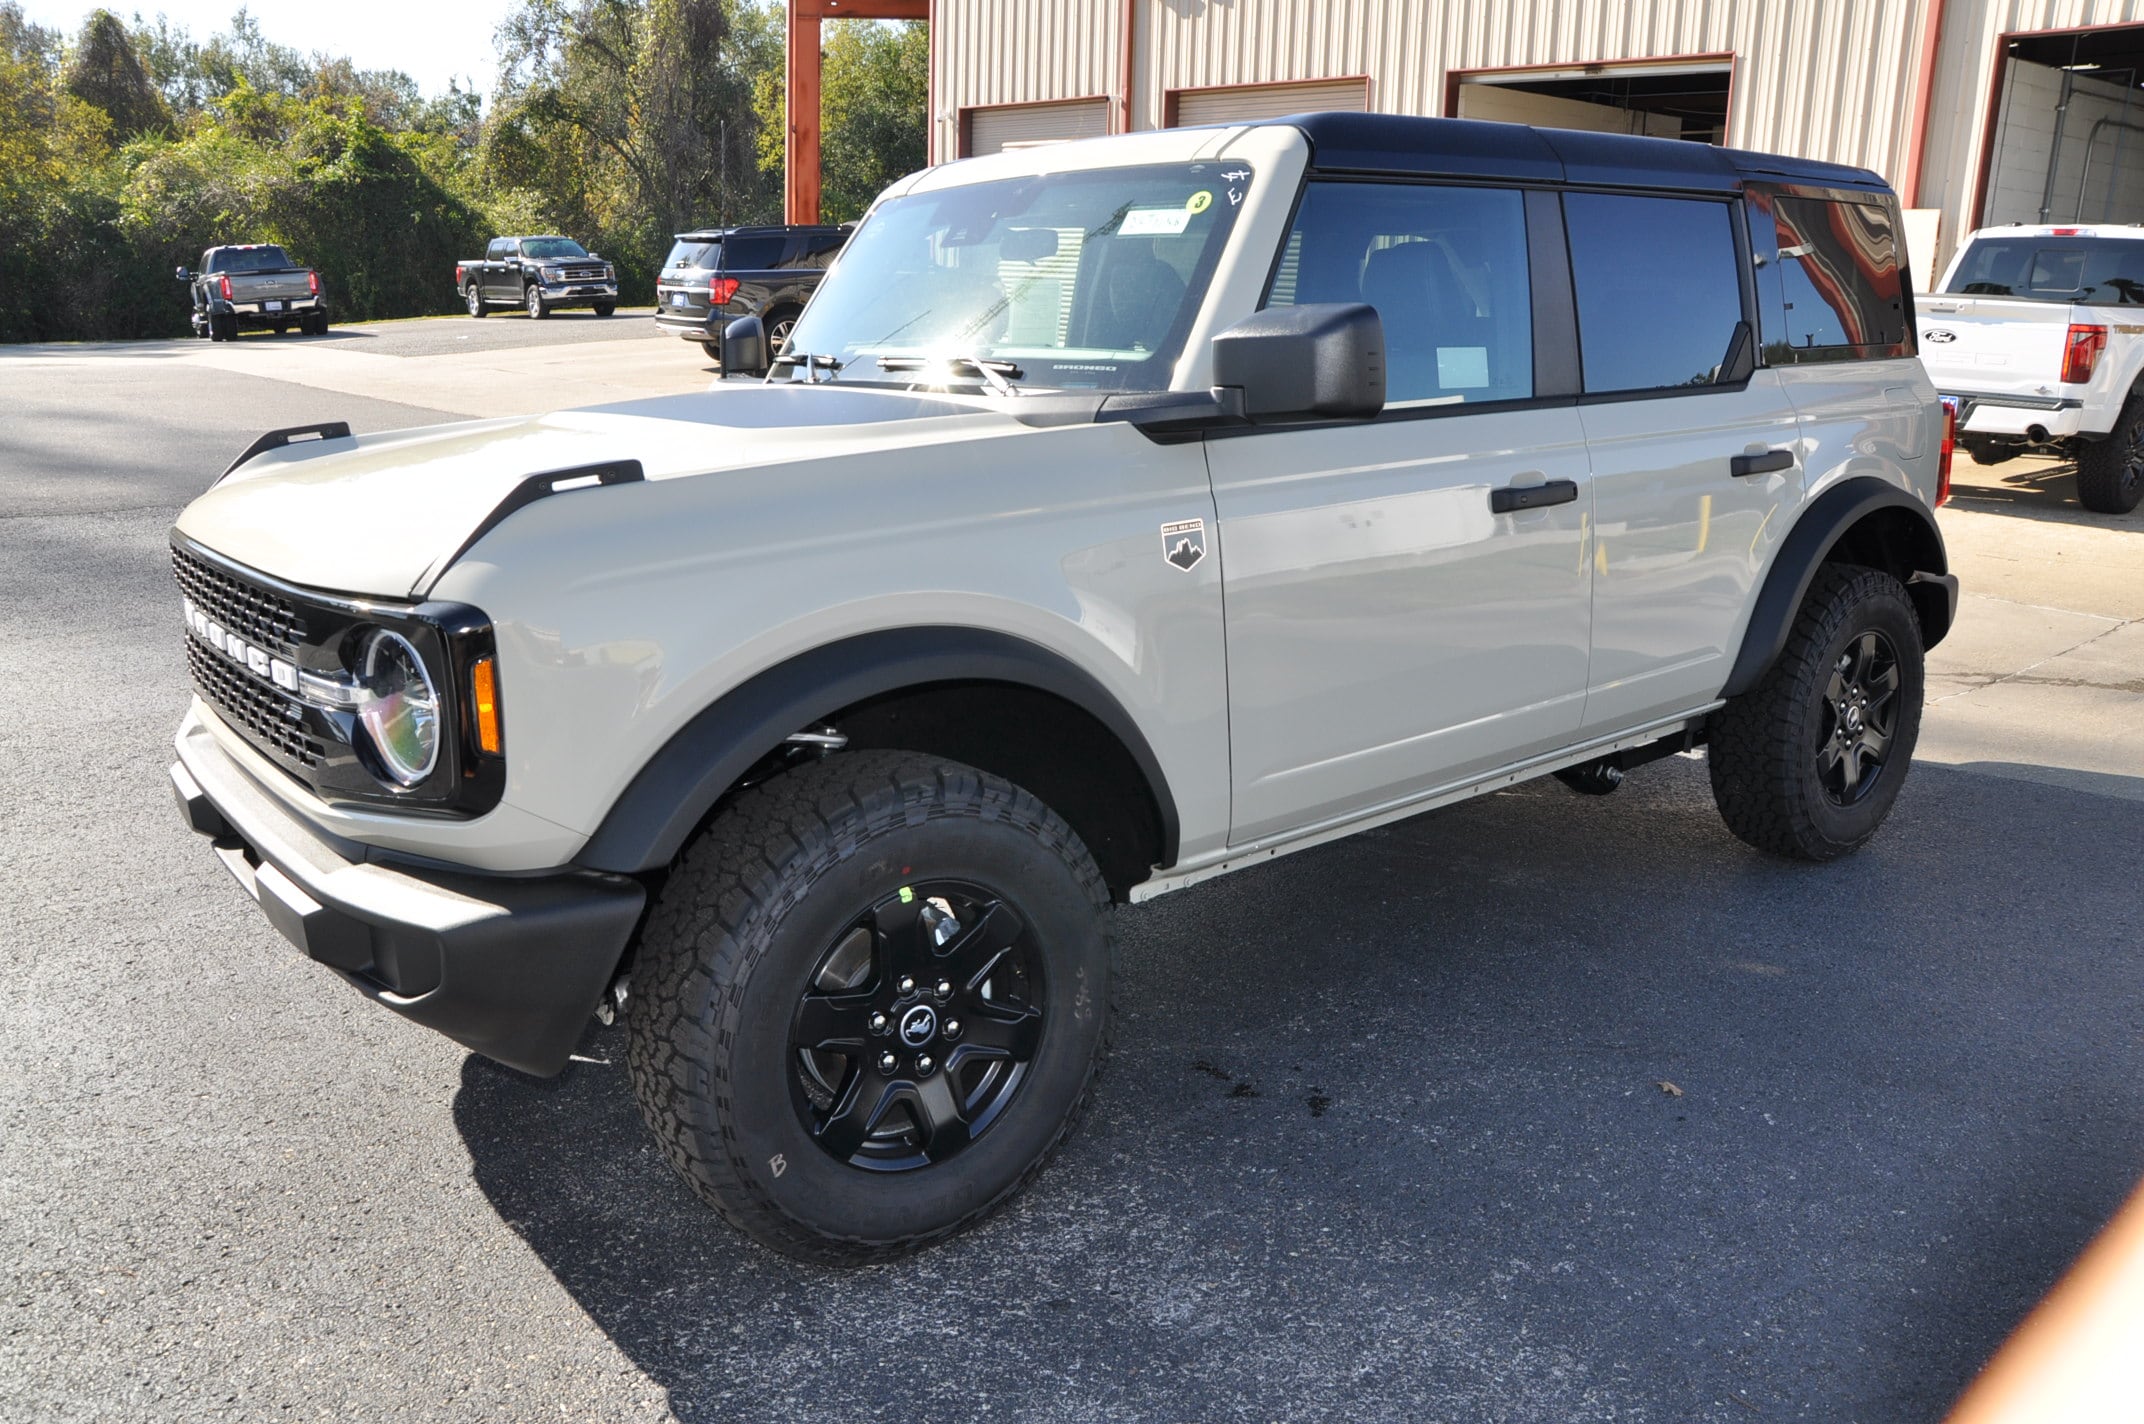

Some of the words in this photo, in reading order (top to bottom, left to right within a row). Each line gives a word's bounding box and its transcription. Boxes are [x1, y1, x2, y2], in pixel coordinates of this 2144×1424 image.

[1194, 195, 1206, 208] 3
[1052, 364, 1117, 372] BRONCO
[1179, 521, 1201, 531] BEND
